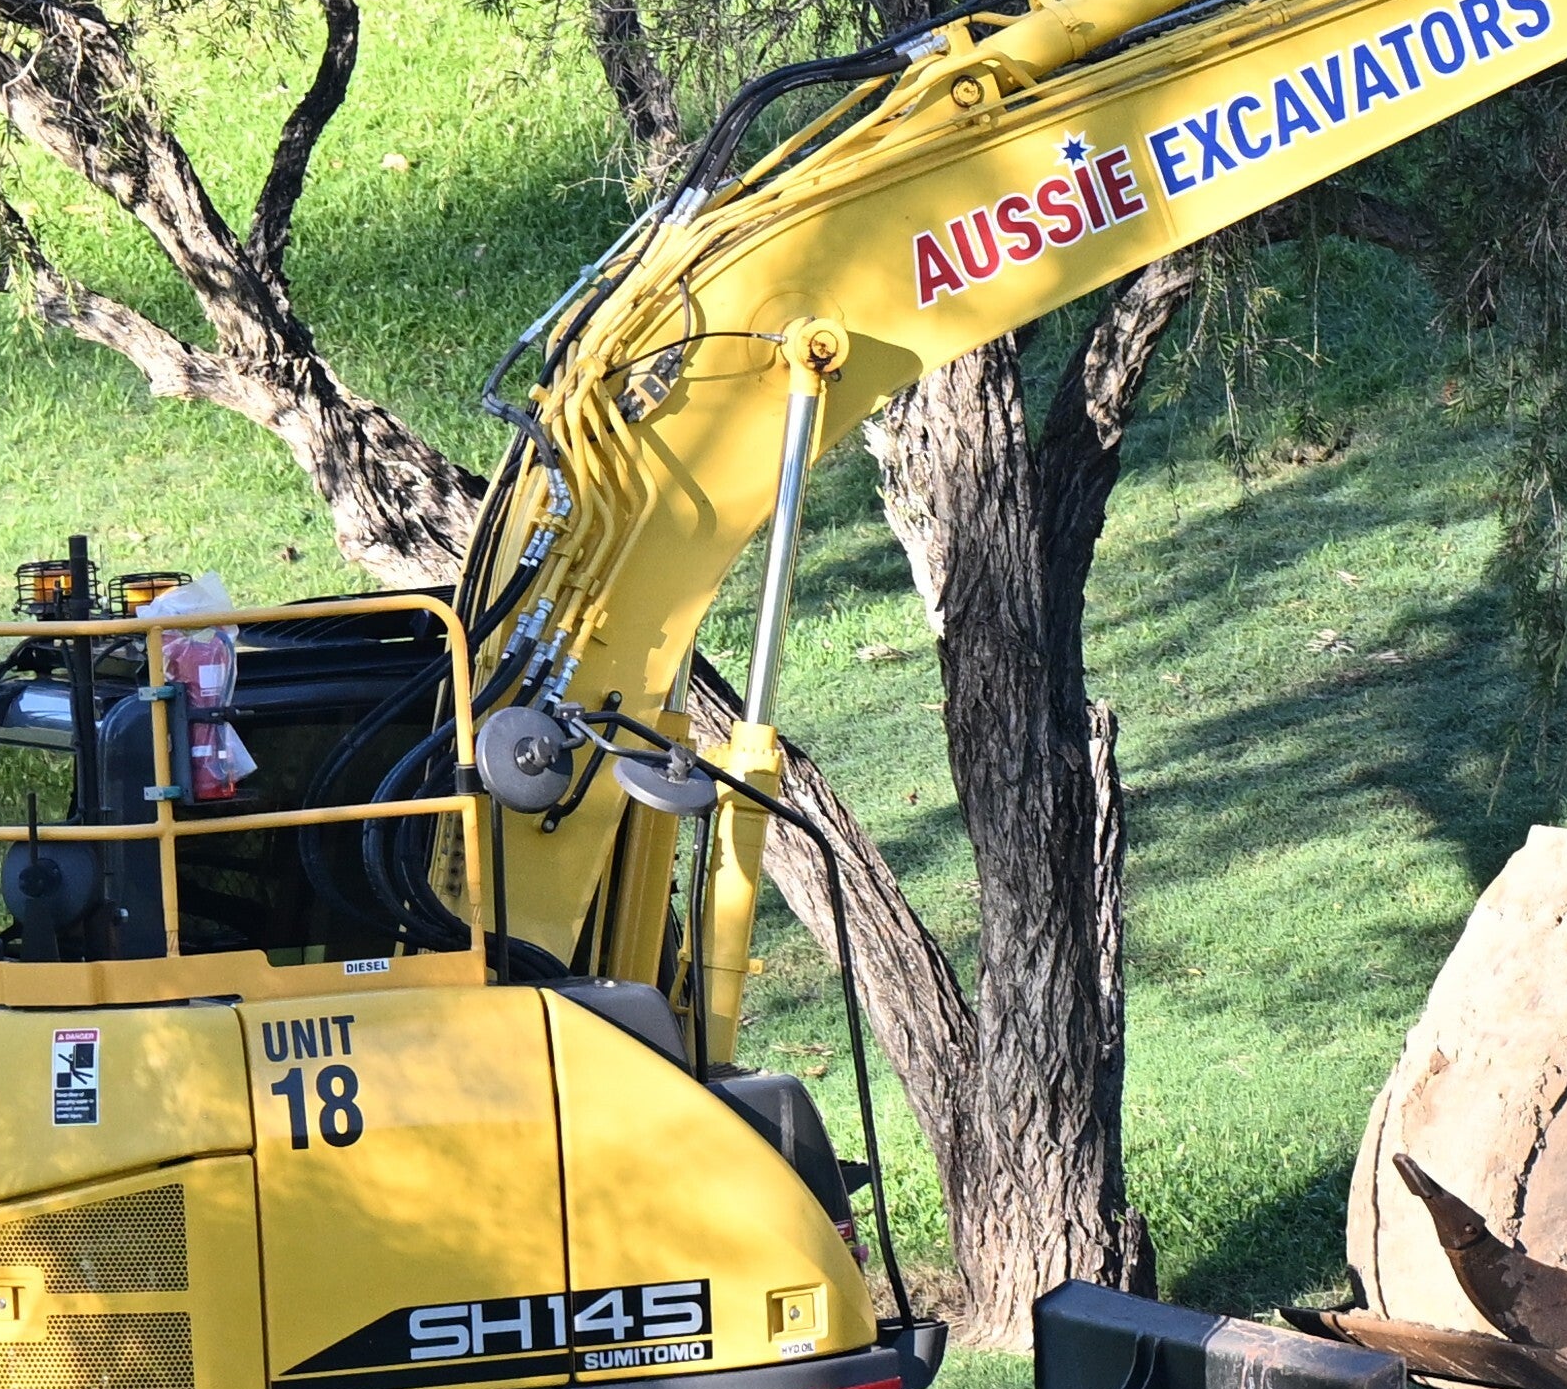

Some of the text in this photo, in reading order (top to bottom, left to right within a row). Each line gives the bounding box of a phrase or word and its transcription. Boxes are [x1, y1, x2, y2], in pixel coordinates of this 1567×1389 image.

[914, 145, 1147, 308] AUSSIE
[346, 960, 389, 974] DIESEL
[65, 1032, 94, 1041] DANGER
[261, 1014, 355, 1062] UNIT
[271, 1064, 364, 1150] 18
[409, 1281, 704, 1360] SH145
[584, 1341, 705, 1371] SUMITOMO
